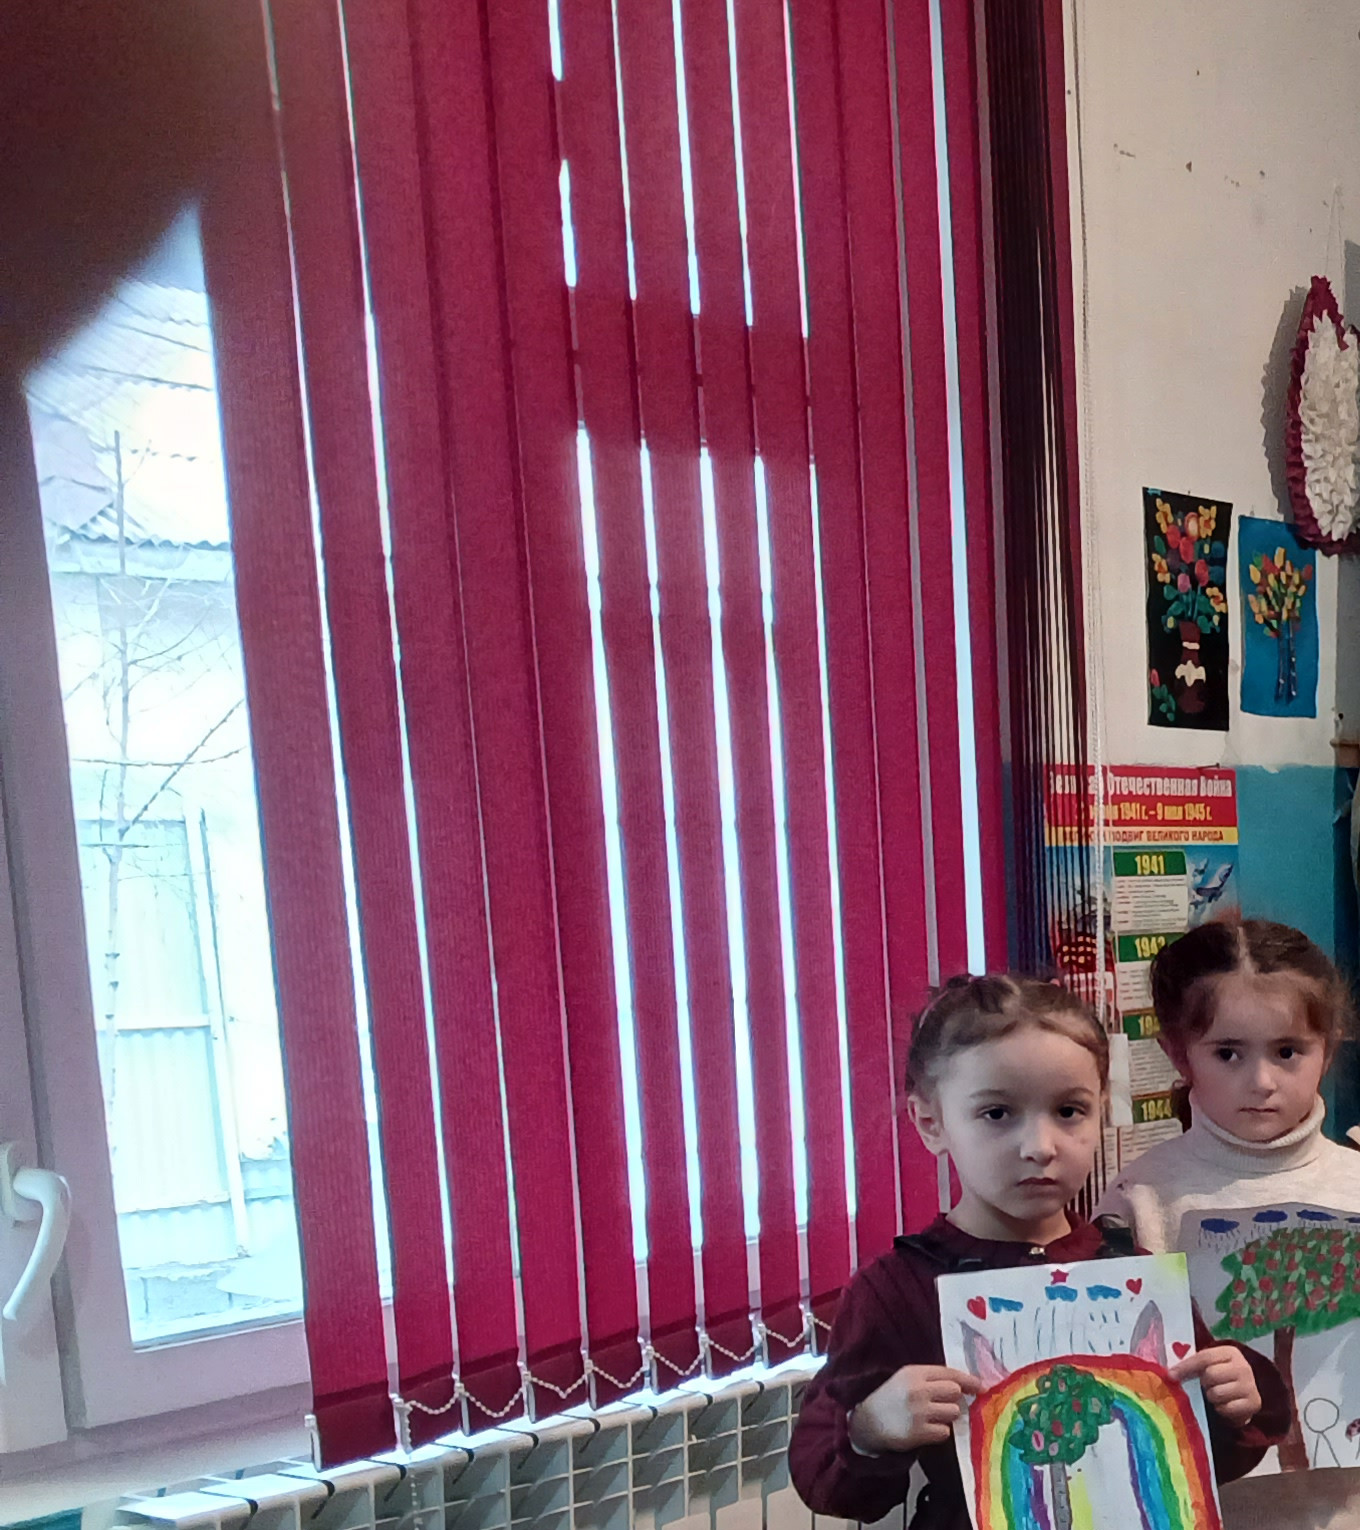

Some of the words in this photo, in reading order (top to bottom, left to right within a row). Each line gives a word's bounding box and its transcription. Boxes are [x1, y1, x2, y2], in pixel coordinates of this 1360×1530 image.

[1107, 772, 1198, 797] Отечественная
[1120, 802, 1140, 821] 1941
[1191, 830, 1224, 842] НАРОДА
[1135, 855, 1165, 875] 1941
[1141, 1099, 1172, 1121] 1944
